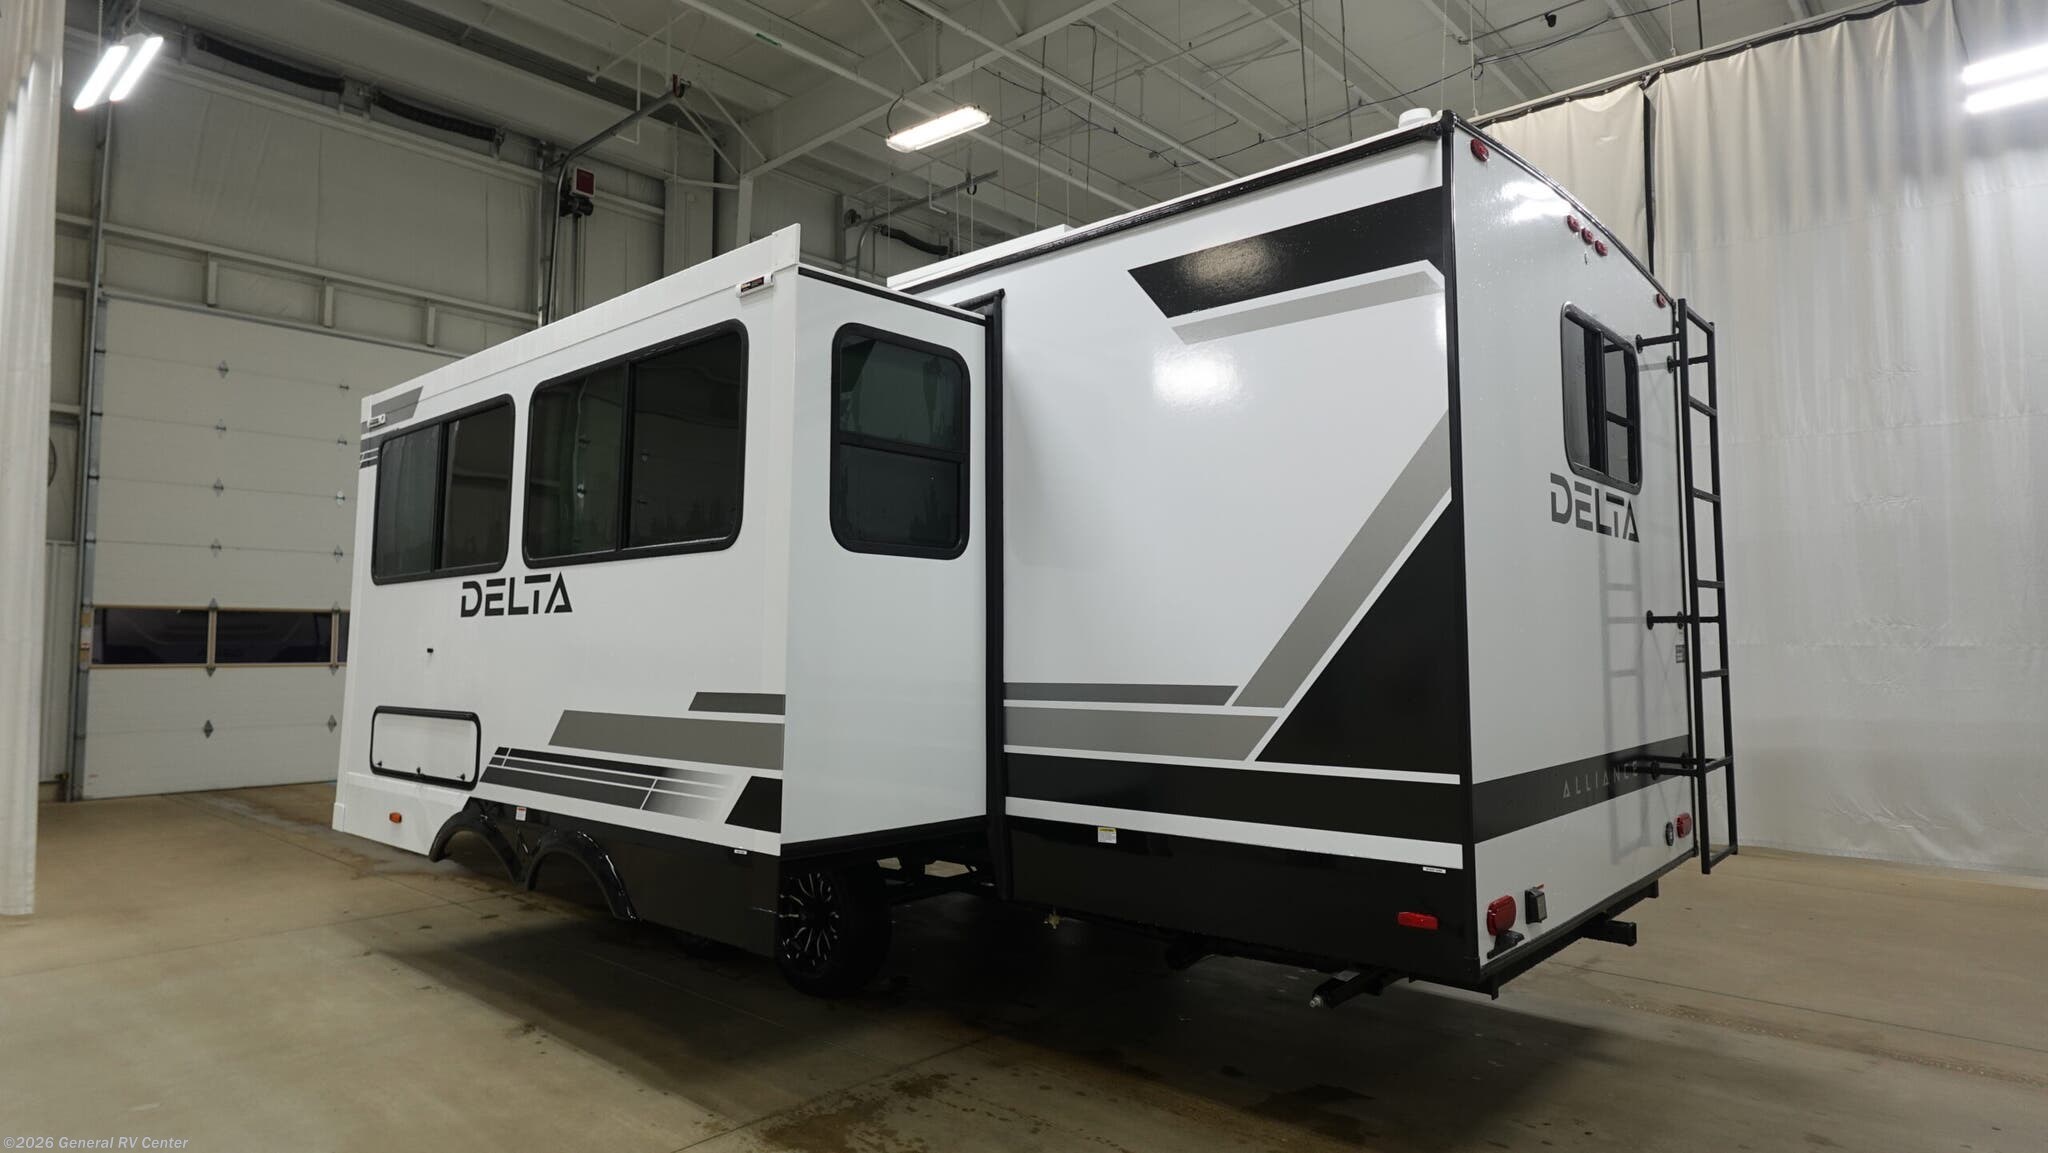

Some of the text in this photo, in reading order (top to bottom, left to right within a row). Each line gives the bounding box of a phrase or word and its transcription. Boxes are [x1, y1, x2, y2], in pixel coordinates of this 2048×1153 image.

[1550, 472, 1640, 543] DELTA
[461, 572, 572, 617] DELTA
[1562, 761, 1638, 798] ALLIANCE
